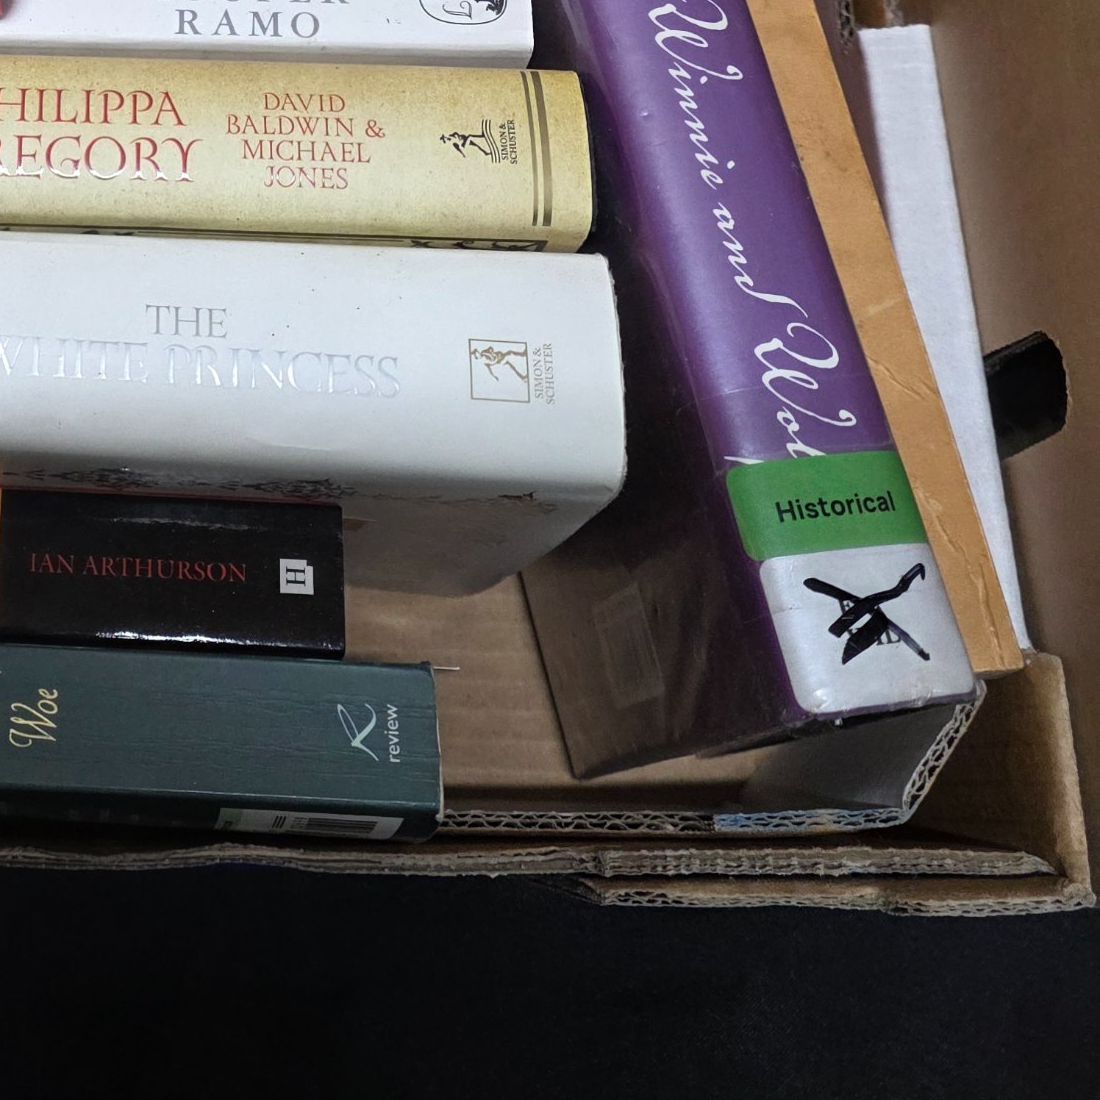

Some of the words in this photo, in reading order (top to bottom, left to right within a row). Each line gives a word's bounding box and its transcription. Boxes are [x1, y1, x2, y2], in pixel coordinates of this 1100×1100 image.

[174, 9, 322, 39] RAMO
[262, 90, 346, 114] DAVID
[225, 114, 356, 138] BALDWIN
[364, 118, 387, 139] &
[507, 119, 518, 165] SCHUSTER
[240, 139, 372, 164] MICHAEL
[499, 131, 509, 161] SIMON
[262, 164, 349, 191] JONES
[712, 200, 809, 319] and
[145, 302, 228, 339] THE
[166, 341, 402, 400] PRINCESS
[532, 358, 544, 399] SIMON
[543, 343, 556, 405] SCHUSTER
[775, 490, 897, 525] Historical
[27, 551, 76, 576] IAN
[82, 555, 247, 584] ARTHURSON
[8, 686, 60, 750] Woe
[386, 703, 401, 763] review
